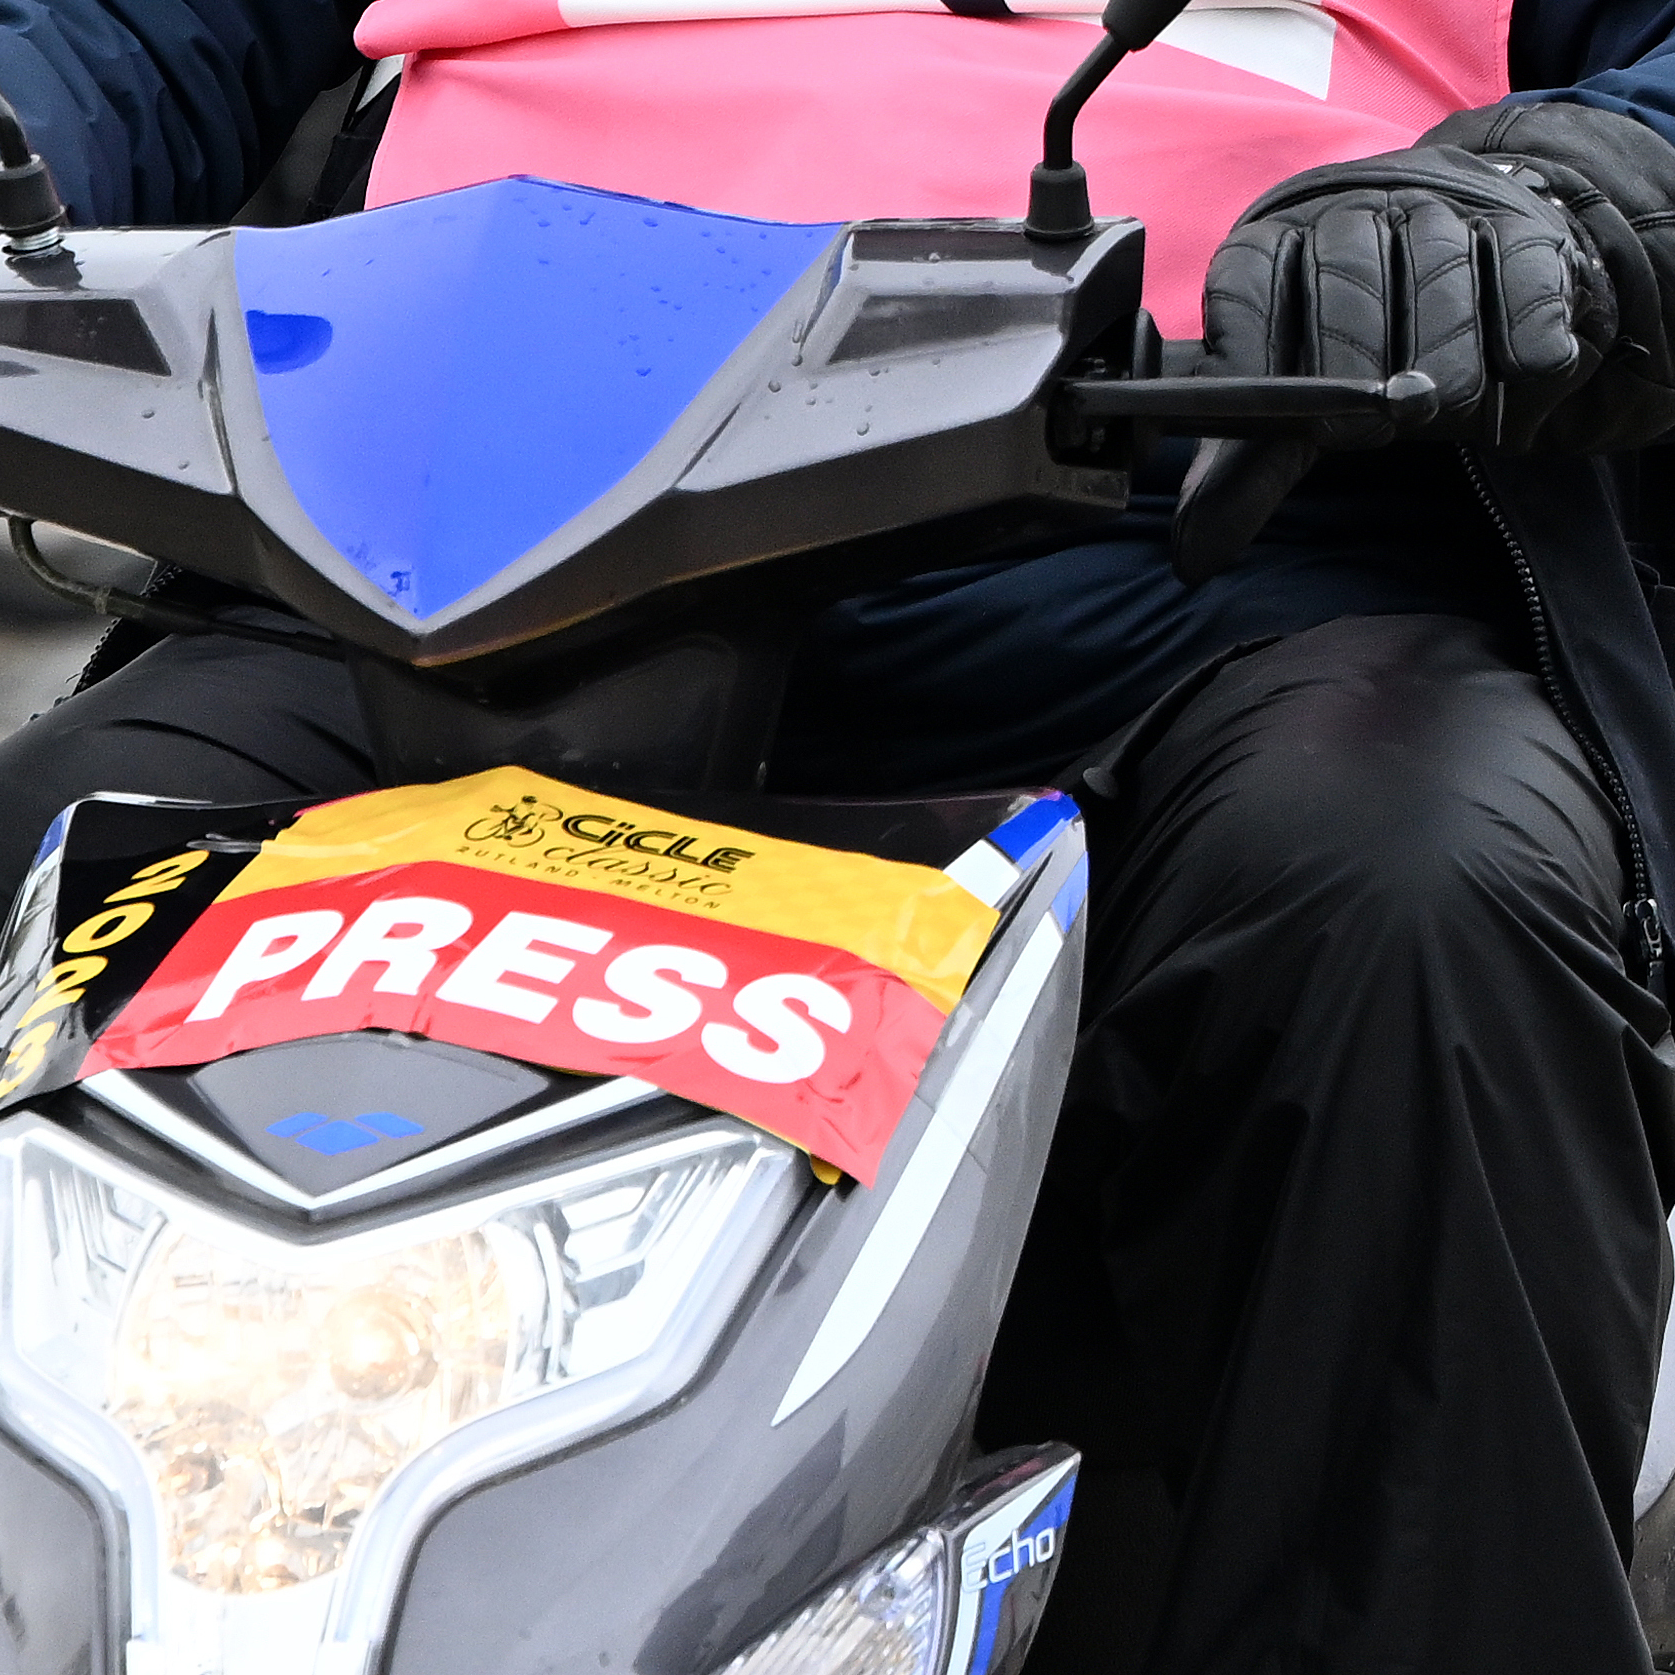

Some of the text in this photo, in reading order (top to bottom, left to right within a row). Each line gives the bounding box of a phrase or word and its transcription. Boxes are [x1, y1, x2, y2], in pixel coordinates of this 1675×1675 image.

[543, 843, 734, 897] classic
[609, 877, 722, 910] MELTON
[183, 895, 853, 1085] PRESS
[961, 1526, 1056, 1592] Echo
